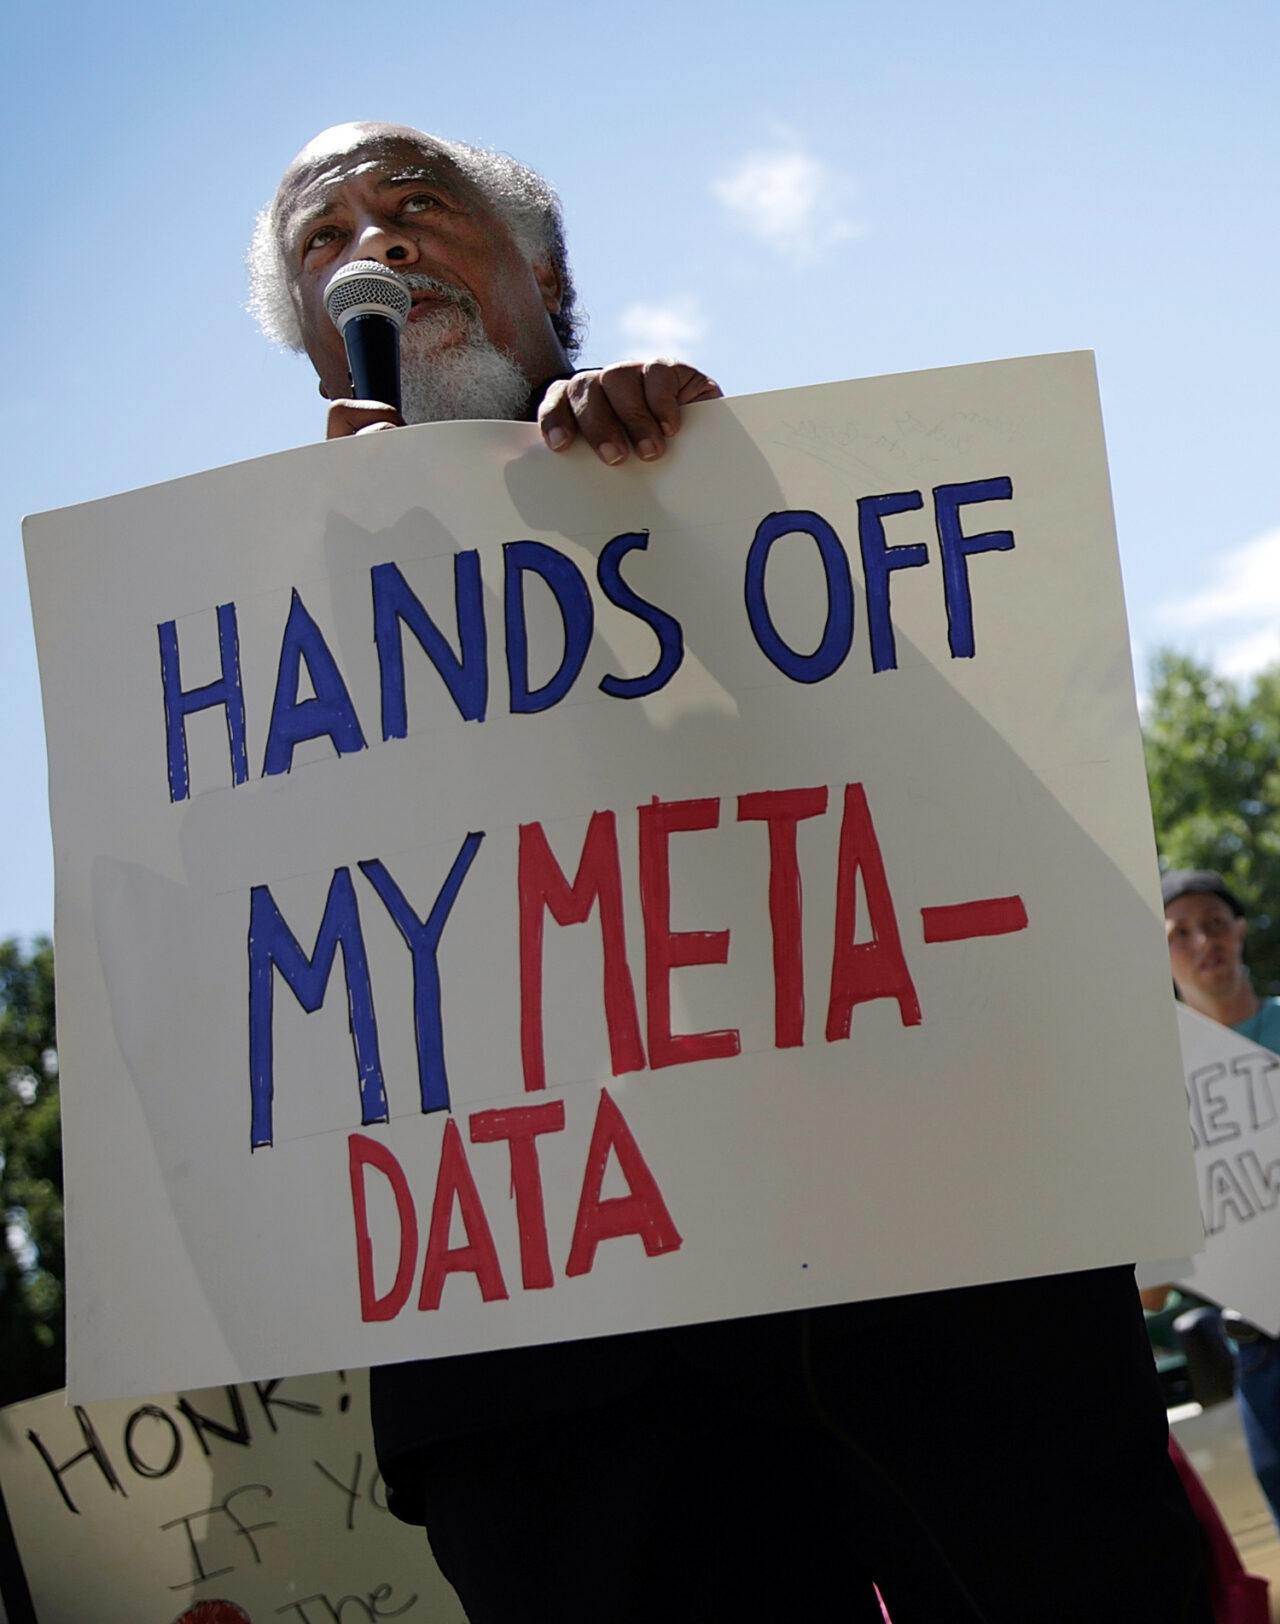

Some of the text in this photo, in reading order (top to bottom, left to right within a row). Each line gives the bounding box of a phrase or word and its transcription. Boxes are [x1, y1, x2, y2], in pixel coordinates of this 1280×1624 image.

[157, 476, 1016, 804] HANDS OFF
[248, 781, 1030, 1154] MY META-
[1188, 1050, 1280, 1149] ET
[348, 1088, 684, 1324] DATA
